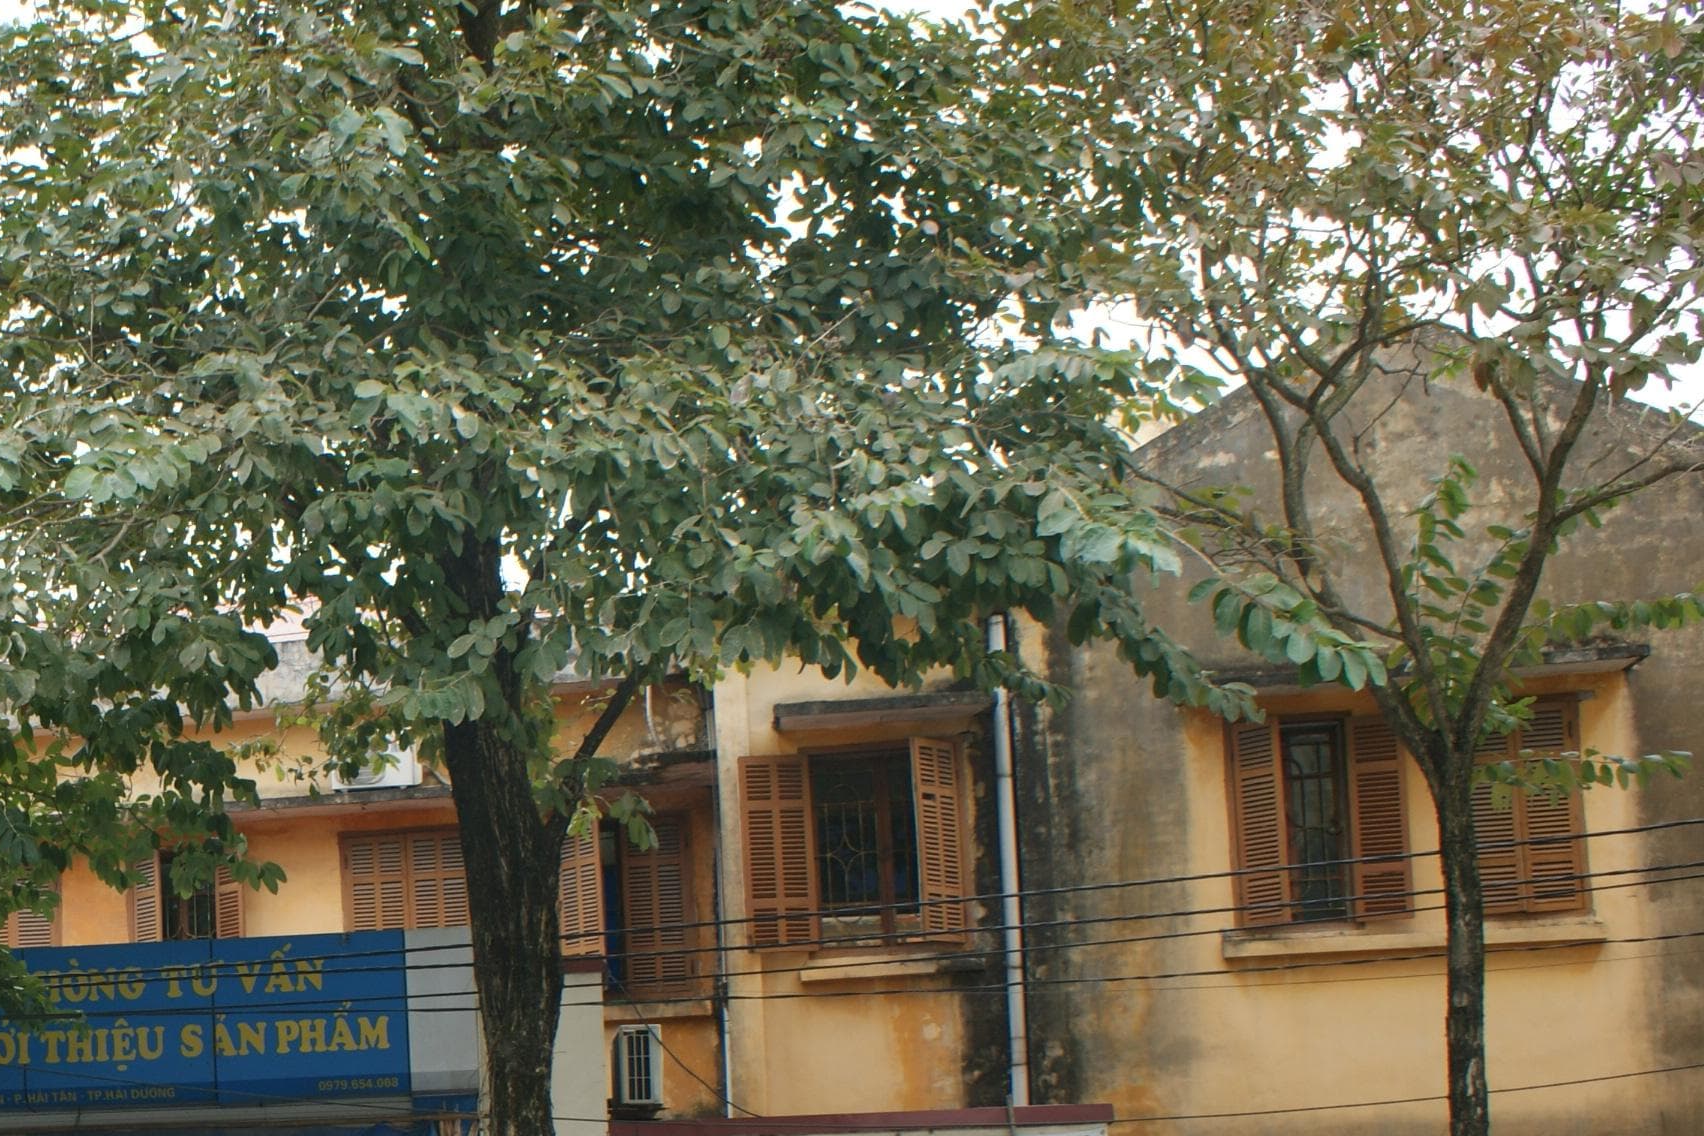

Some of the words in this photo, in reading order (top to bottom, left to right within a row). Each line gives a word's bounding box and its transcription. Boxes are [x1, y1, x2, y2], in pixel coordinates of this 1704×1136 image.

[235, 943, 325, 994] VẤN
[41, 1018, 165, 1072] THIỆU
[275, 1002, 390, 1054] PHẨM
